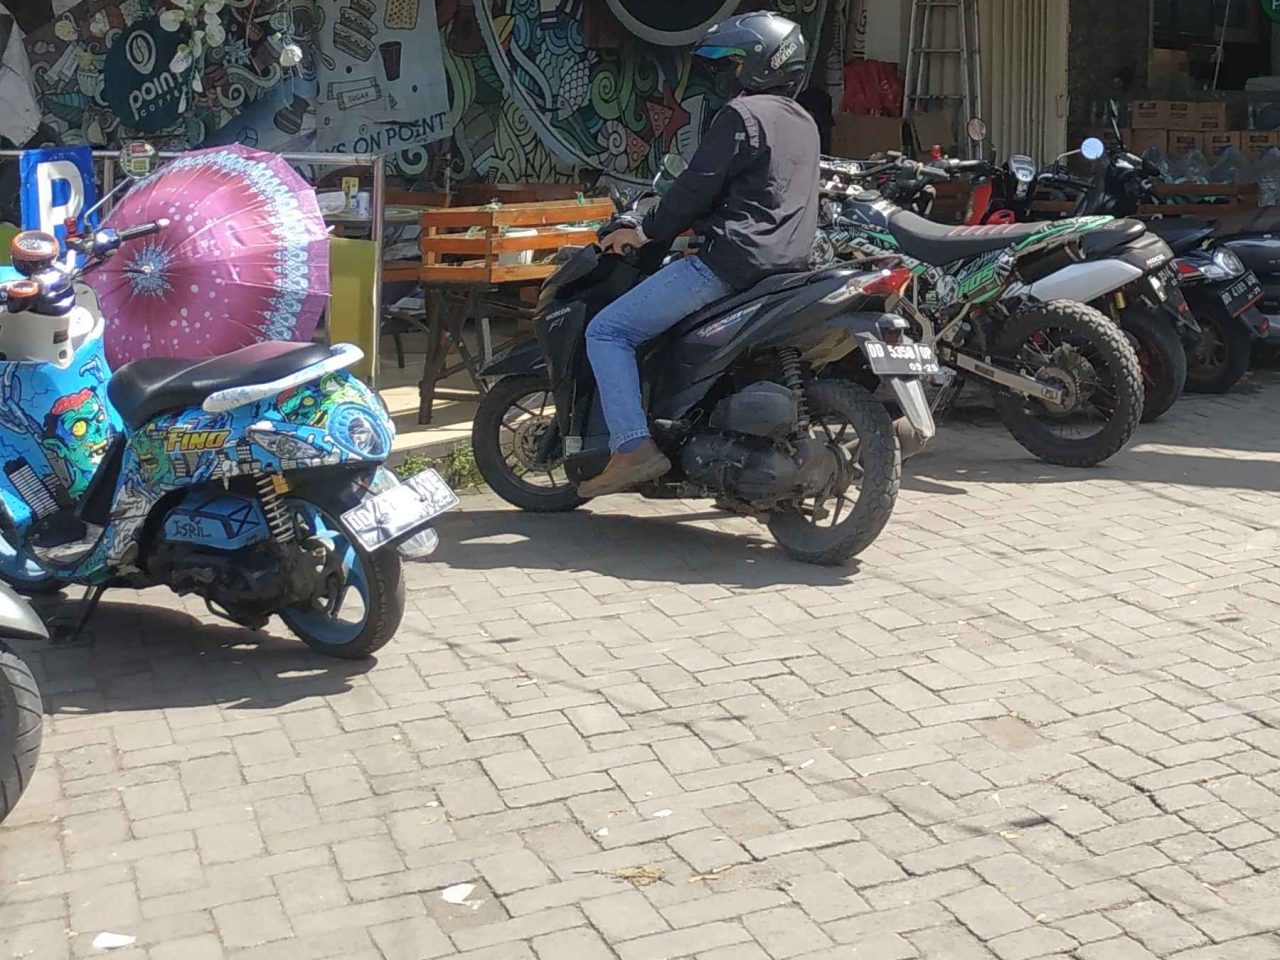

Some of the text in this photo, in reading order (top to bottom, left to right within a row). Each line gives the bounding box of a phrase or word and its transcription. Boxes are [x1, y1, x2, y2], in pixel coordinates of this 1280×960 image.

[353, 111, 447, 154] ON POINT
[37, 160, 85, 240] P
